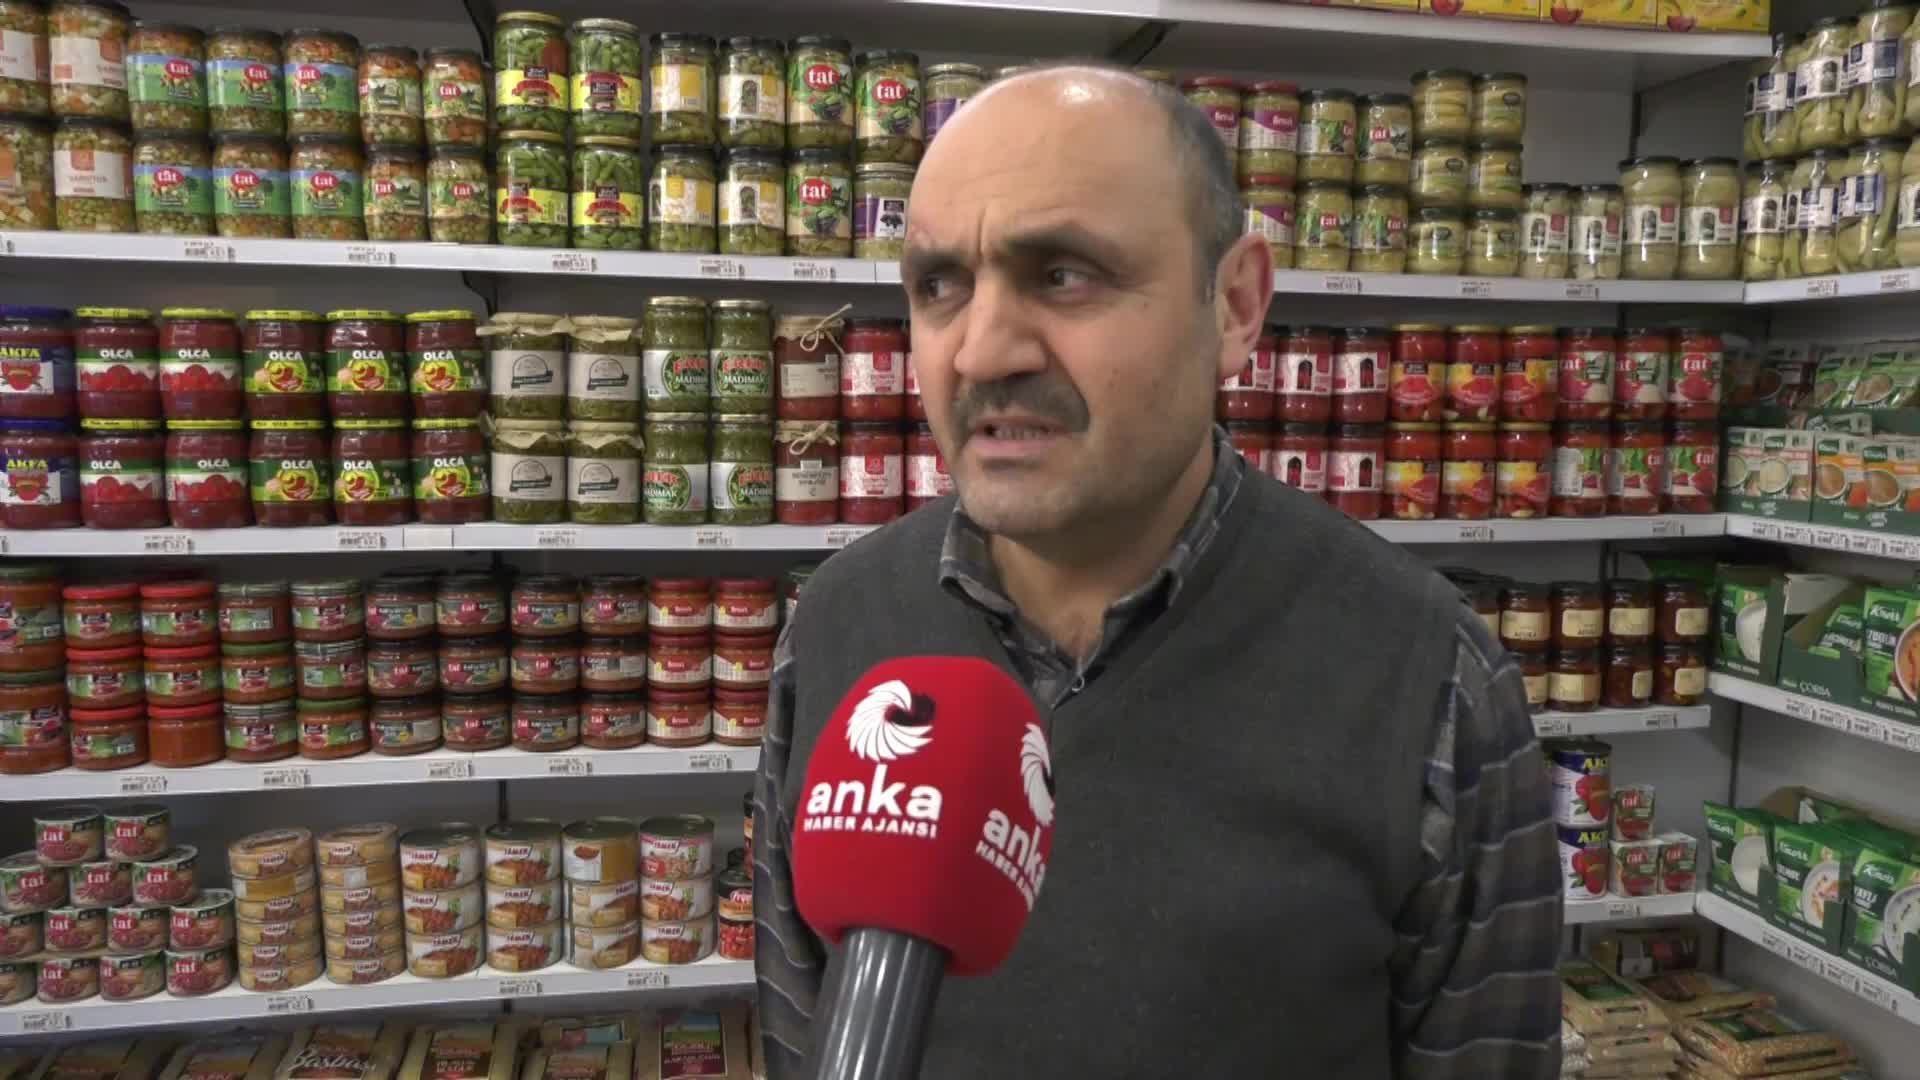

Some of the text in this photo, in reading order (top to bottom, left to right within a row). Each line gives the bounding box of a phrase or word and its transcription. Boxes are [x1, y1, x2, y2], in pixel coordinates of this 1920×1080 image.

[168, 62, 190, 76] tat
[249, 67, 270, 80] tat
[299, 68, 318, 80] tat
[808, 70, 835, 85] tat
[440, 86, 458, 97] tat
[876, 84, 903, 99] tat
[1369, 126, 1388, 140] tat
[157, 170, 179, 184] tat
[235, 173, 256, 186] tat
[314, 174, 335, 188] tat
[802, 184, 829, 199] tat
[100, 348, 134, 360] OLCA
[178, 348, 210, 360] OLCA
[269, 350, 303, 361] OLCA
[352, 350, 385, 361] OLCA
[423, 350, 455, 361] OLCA
[1682, 358, 1708, 371] tat
[90, 459, 122, 471] OLCA
[197, 458, 230, 469] OLCA
[281, 459, 314, 471] OLCA
[343, 460, 374, 471] OLCA
[434, 457, 465, 469] OLCA
[806, 763, 943, 821] anka
[116, 826, 139, 839] tat
[803, 816, 937, 839] HABER AJANSI
[43, 830, 65, 842] tat
[20, 876, 45, 889] tat
[87, 872, 111, 884] tat
[146, 871, 169, 883] tat
[50, 918, 69, 930] tat
[112, 918, 132, 930] tat
[172, 916, 192, 928] tat
[175, 961, 196, 973] tat
[43, 967, 62, 980] tat
